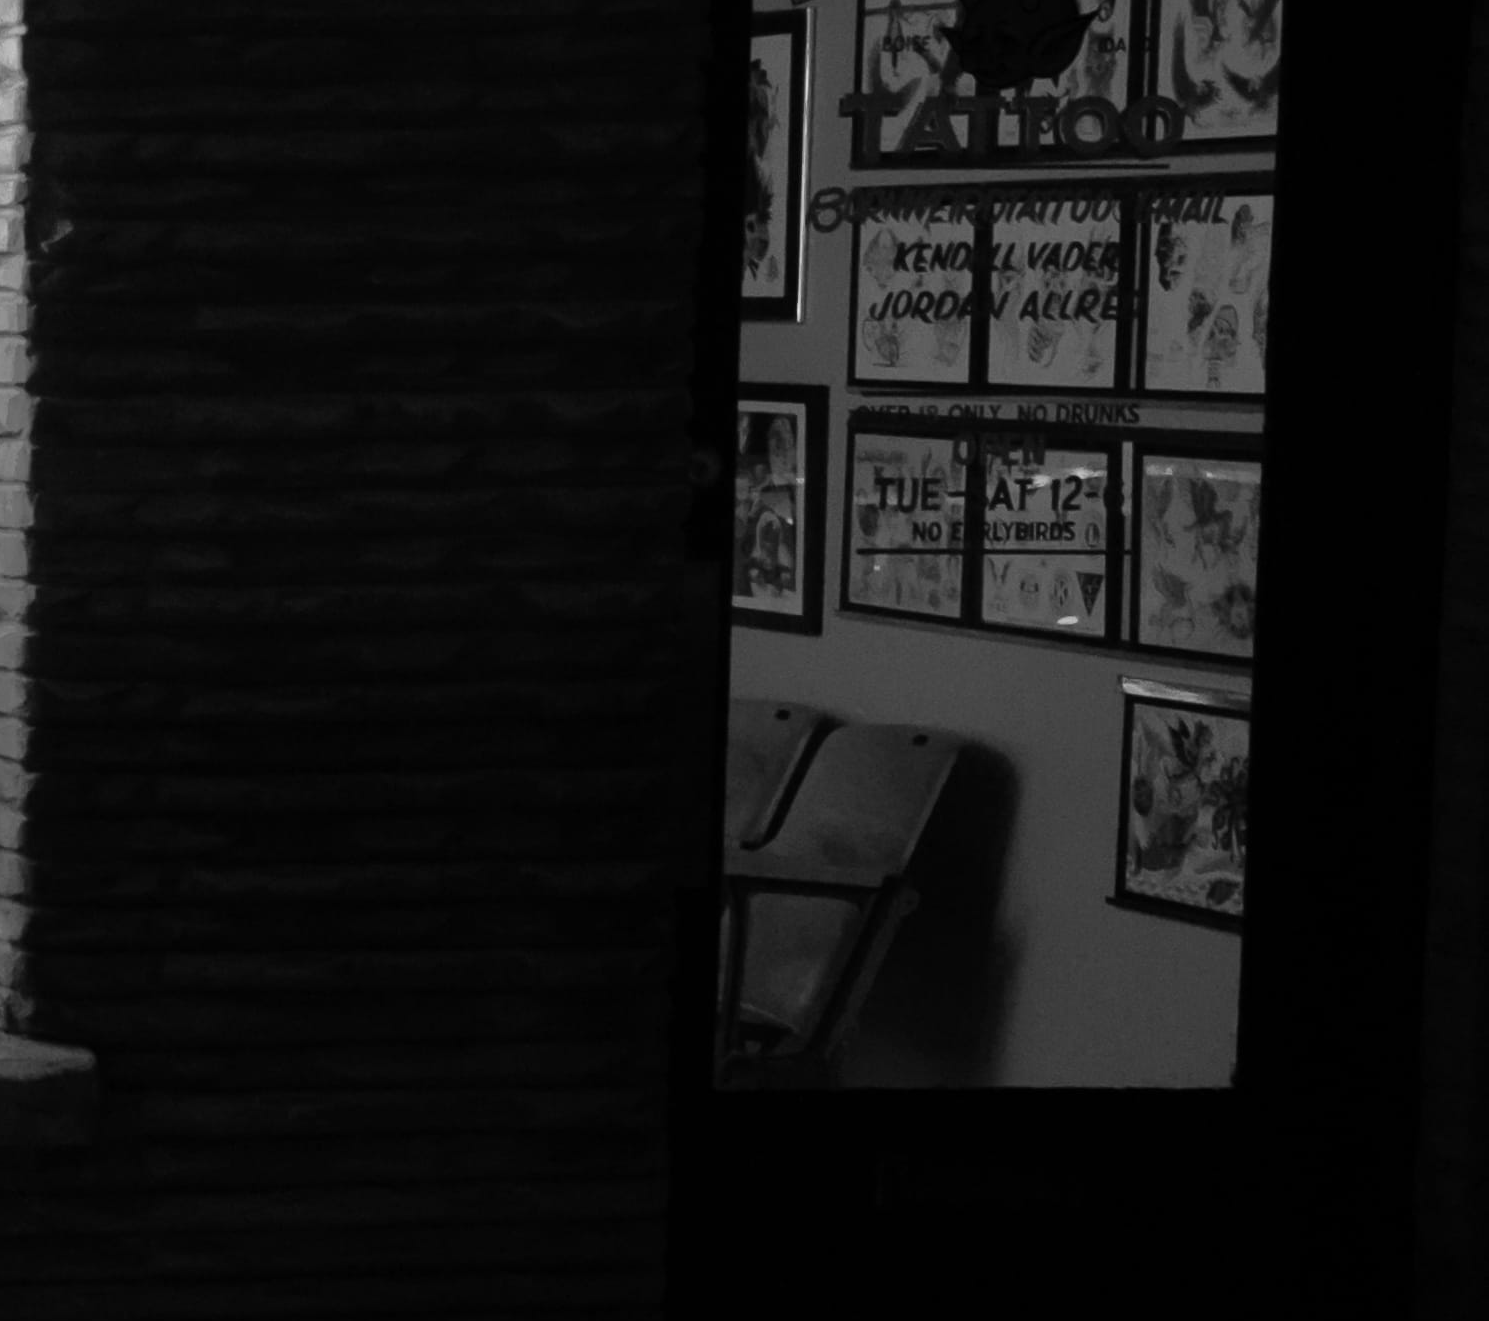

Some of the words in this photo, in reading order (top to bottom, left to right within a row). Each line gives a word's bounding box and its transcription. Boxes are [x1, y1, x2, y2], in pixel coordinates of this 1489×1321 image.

[1099, 35, 1158, 54] IDAO
[838, 92, 1186, 162] TATTOO
[892, 241, 1017, 274] KENDLL
[1055, 403, 1142, 425] DRUNKS
[912, 522, 941, 541] NO
[951, 522, 1076, 541] ERLYBIRDS
